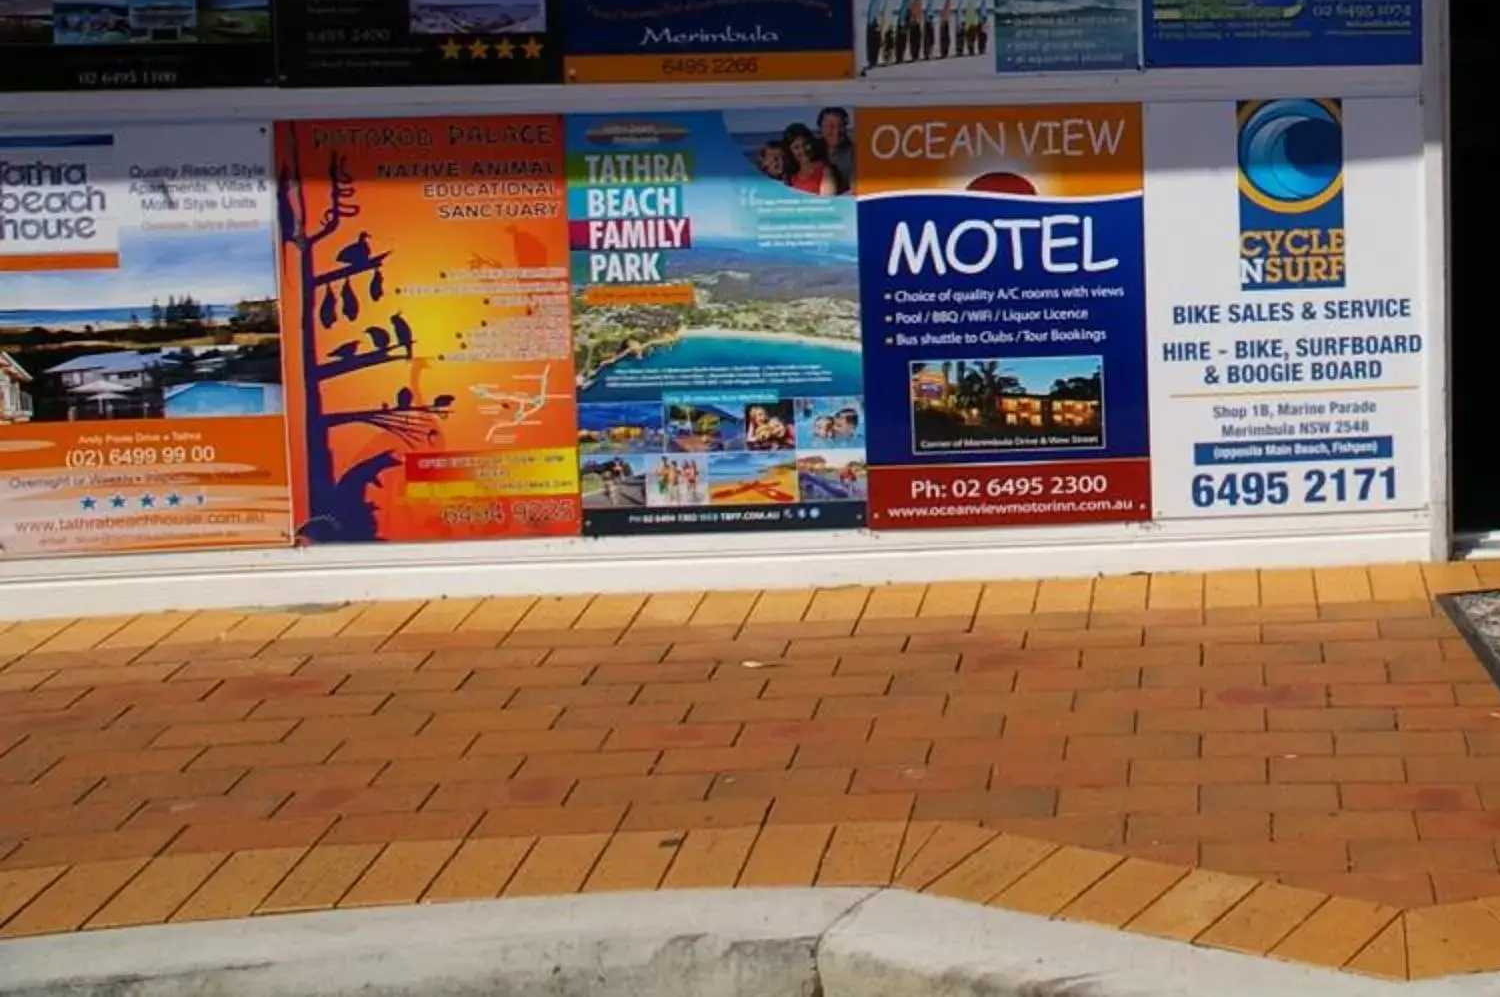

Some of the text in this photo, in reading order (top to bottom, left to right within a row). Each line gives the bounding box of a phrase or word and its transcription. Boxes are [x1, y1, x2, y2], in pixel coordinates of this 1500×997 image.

[637, 24, 780, 46] Merimbula
[871, 118, 1126, 160] OCEAN VIEW
[376, 160, 555, 179] NATIVE ANIMAL
[585, 153, 689, 184] TATHRA
[422, 182, 557, 199] EDUCATIONAL
[587, 187, 677, 218] BEACH
[437, 202, 560, 220] SANCTUARY
[588, 219, 687, 250] FAMILY
[887, 214, 1120, 277] MOTEL
[1240, 228, 1345, 257] CYCLE
[590, 252, 661, 283] PARK
[895, 289, 936, 303] Choice
[937, 288, 952, 303] of
[953, 288, 994, 304] quality
[1021, 288, 1059, 300] rooms
[1061, 285, 1089, 299] with
[1091, 284, 1125, 297] views
[896, 311, 923, 325] Pool
[931, 311, 958, 325] BBQ
[1002, 308, 1042, 324] Liquor
[1043, 307, 1089, 320] Licence
[1173, 298, 1412, 325] BIKE SALES & SERVICE
[896, 327, 1107, 346] Bus shuttle to Clubs Tour Bookings
[1163, 334, 1422, 362] HIRE BIKE, SURFBOARD
[1203, 360, 1382, 385] & BOOGIE BOARD
[1213, 405, 1247, 422] Shop
[1278, 402, 1326, 416] Marine
[1330, 400, 1377, 415] Parade
[1221, 420, 1369, 438] Merimbula NSW 2548
[65, 445, 215, 469] (02) 6499 99 00
[911, 475, 1108, 499] Ph: 02 6495 2300
[1191, 466, 1396, 508] 6495 2171
[888, 499, 1133, 518] www.oceanviewmotorinn.com.au
